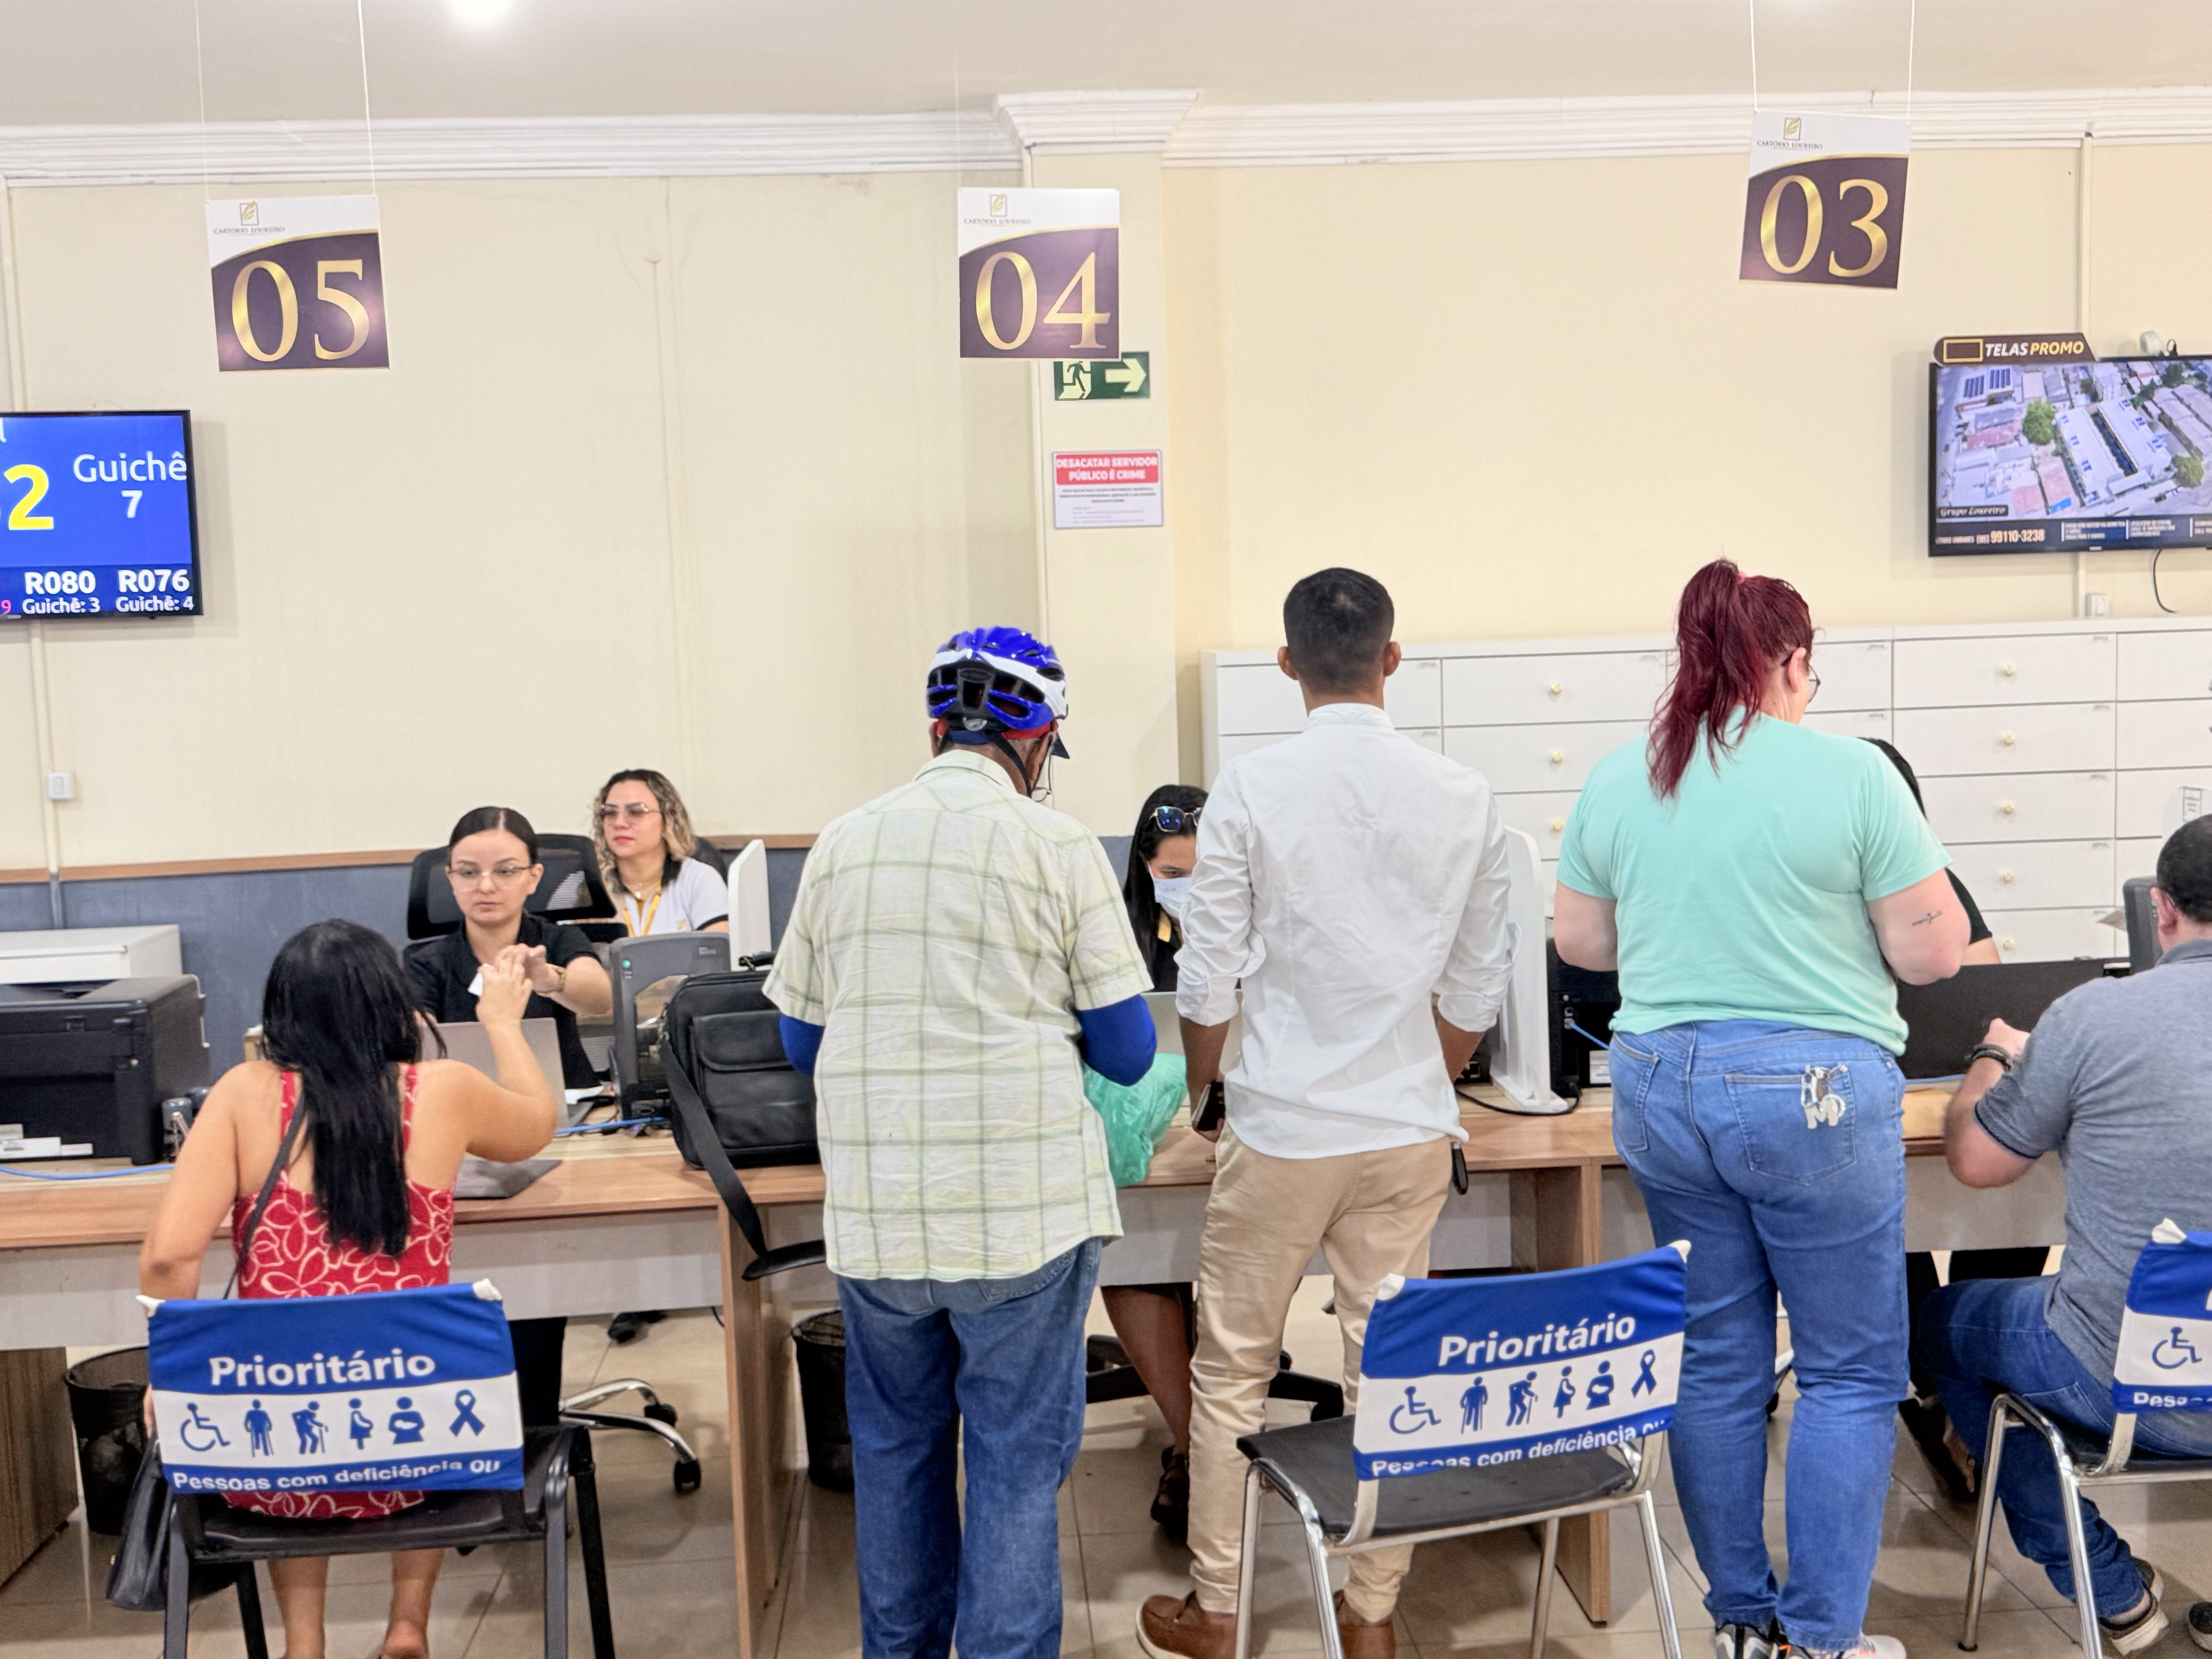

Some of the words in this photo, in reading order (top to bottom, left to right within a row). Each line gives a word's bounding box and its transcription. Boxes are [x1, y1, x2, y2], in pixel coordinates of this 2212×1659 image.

[1760, 174, 1888, 277] 03
[232, 259, 369, 362] 05
[976, 251, 1111, 350] 04
[1985, 342, 2028, 357] TELAS
[2030, 341, 2084, 356] PROMO
[73, 450, 187, 483] Guichê
[0, 464, 54, 530] 2
[121, 489, 143, 519] 7
[24, 570, 96, 594] R080
[118, 569, 190, 592] R076
[1, 599, 12, 614] 9
[22, 598, 86, 614] Guichê:
[88, 597, 101, 612] 3
[116, 595, 179, 612] Guichê:
[182, 596, 194, 610] 4
[1438, 1313, 1635, 1367] Prioritário
[209, 1348, 435, 1386] Prioritário
[1477, 1448, 1522, 1467] com
[1528, 1423, 1637, 1459] deficiência
[173, 1472, 270, 1491] Pessoas
[277, 1474, 328, 1488] com
